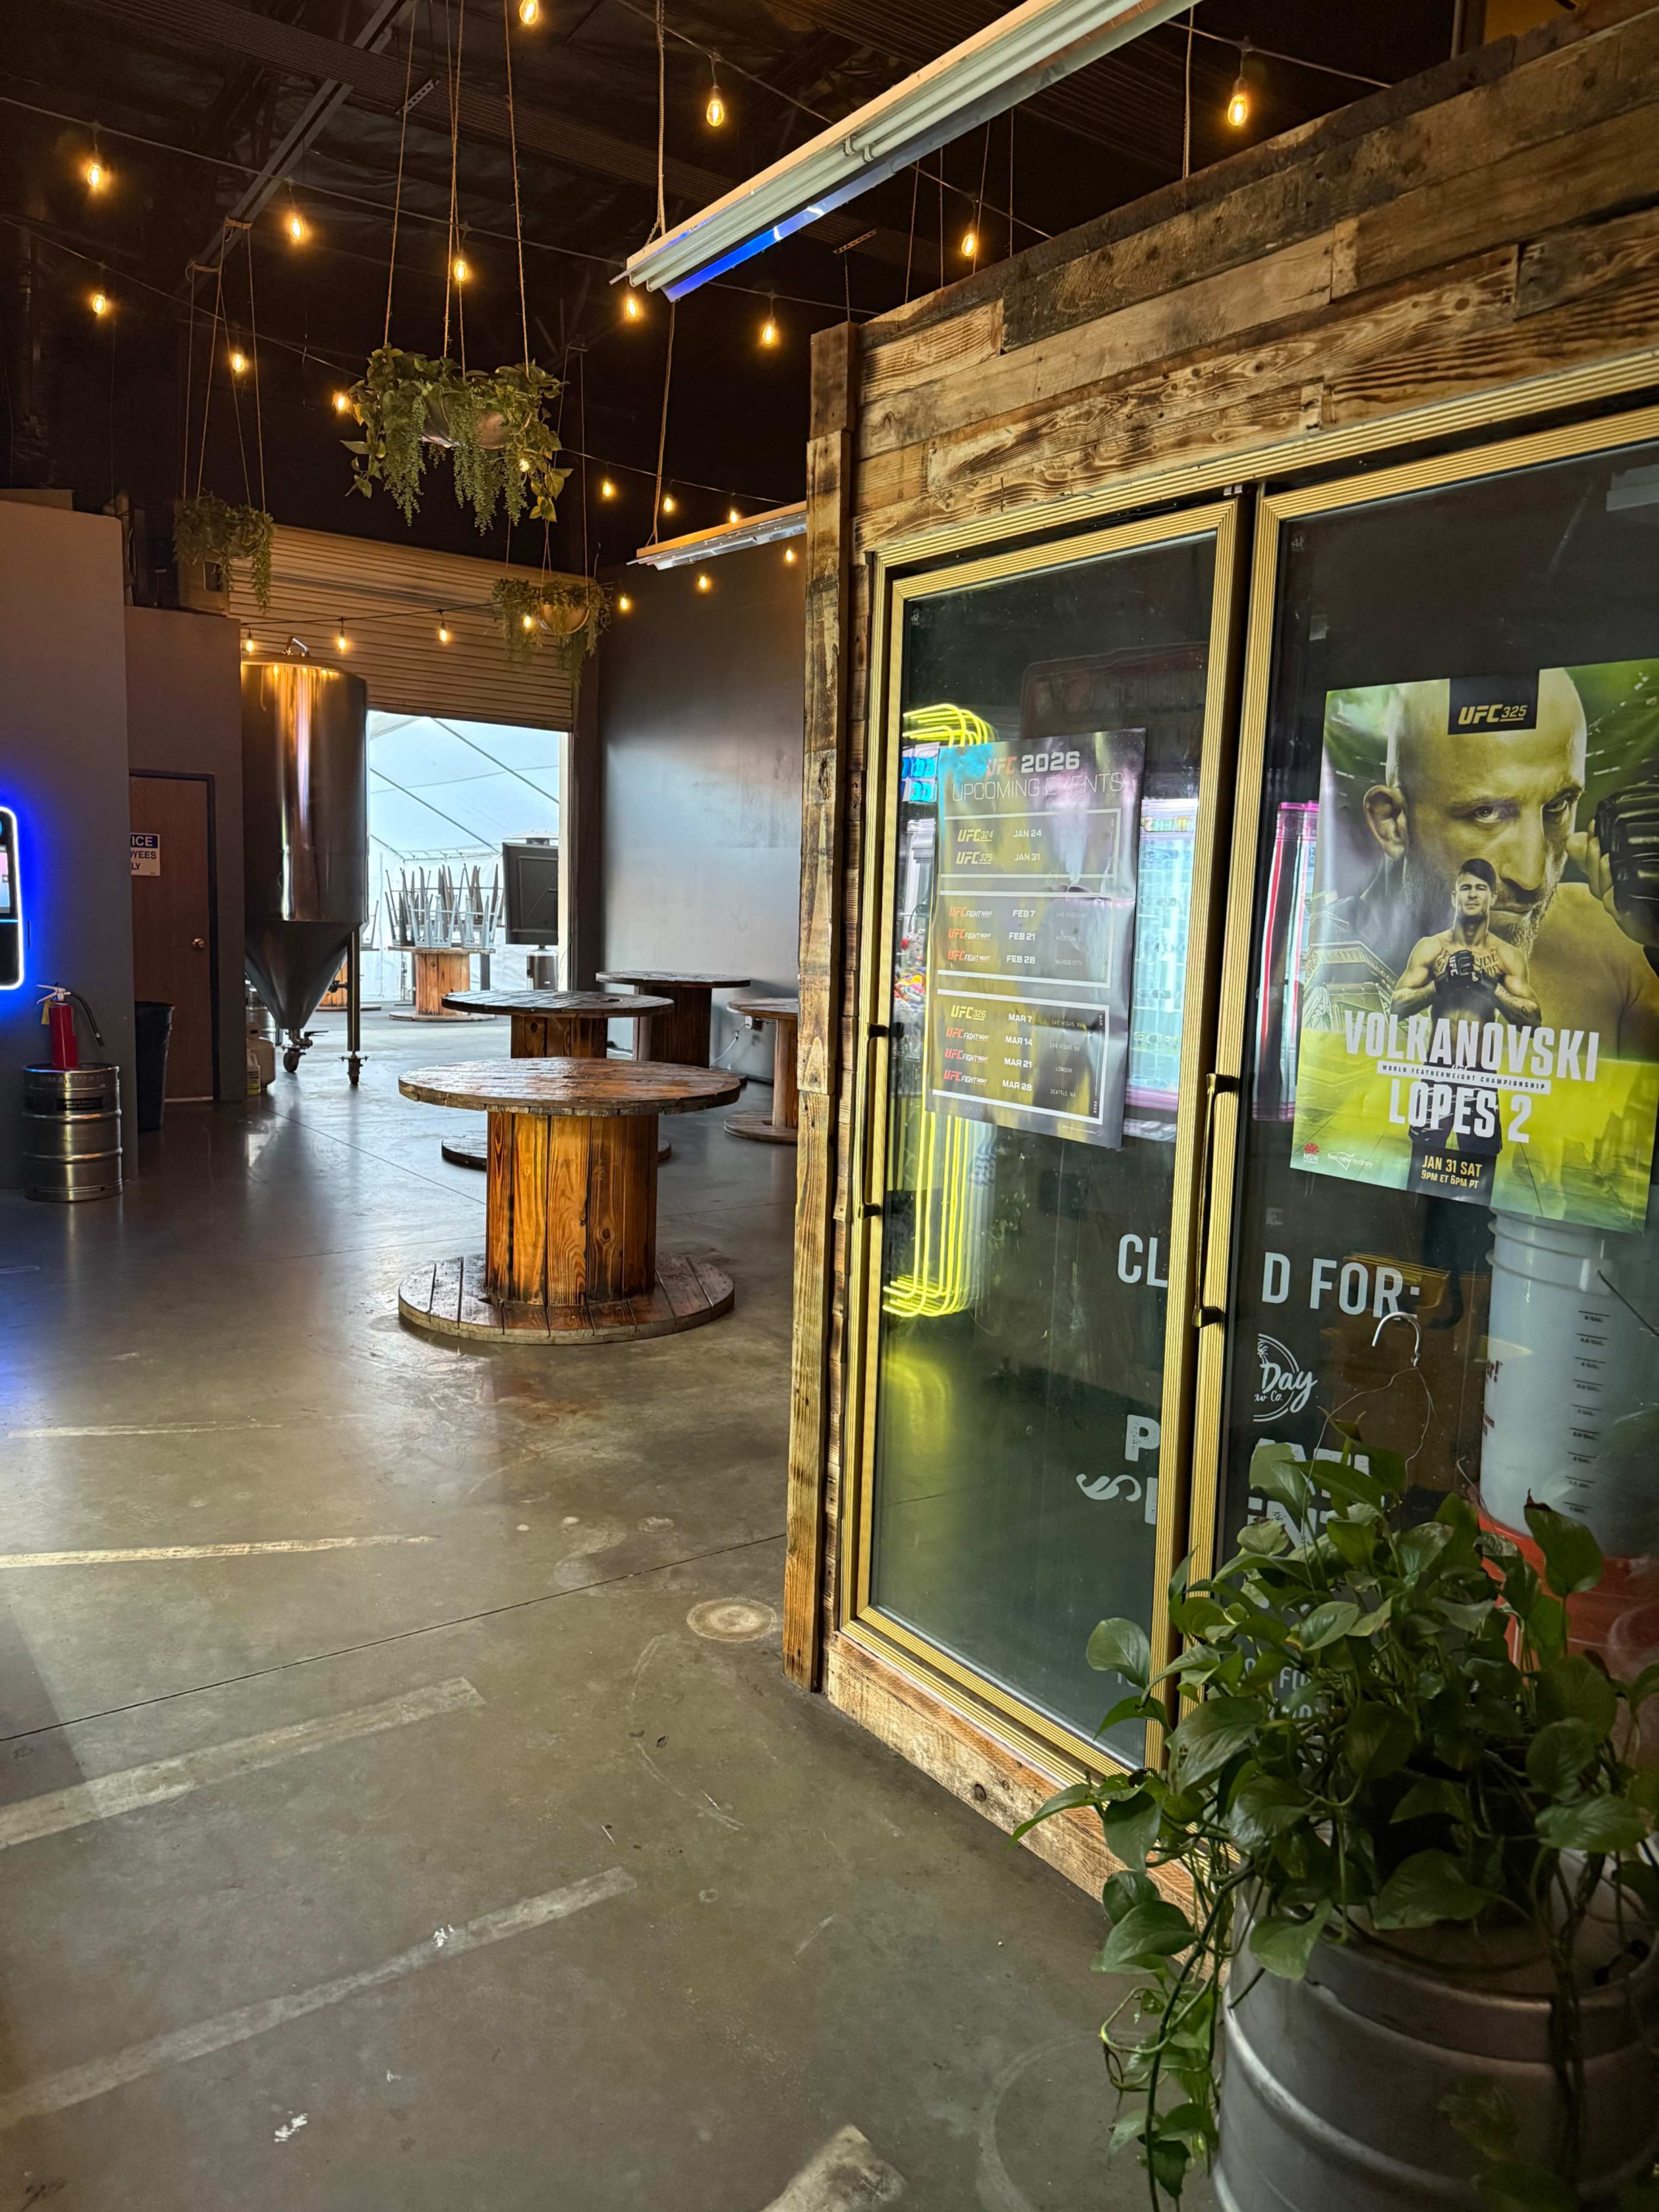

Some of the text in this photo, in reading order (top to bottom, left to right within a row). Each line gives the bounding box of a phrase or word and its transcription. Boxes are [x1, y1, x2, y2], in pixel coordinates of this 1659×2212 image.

[1458, 704, 1528, 725] UFC 325
[1021, 751, 1080, 773] 2026
[953, 779, 1039, 801] UPCOMING
[1046, 773, 1123, 797] EVENTS
[131, 836, 153, 847] ICE
[957, 829, 981, 842] UFC
[1014, 830, 1030, 838] JAN
[956, 851, 980, 864] UFC
[1014, 853, 1030, 861] JAN
[1009, 932, 1025, 940] FEB
[1007, 955, 1023, 964] FEB
[1023, 956, 1035, 964] 28
[951, 1005, 973, 1019] UFC
[1008, 1013, 1026, 1022] MAR
[1005, 1036, 1023, 1045] MAR
[1024, 1038, 1033, 1046] 14
[1344, 1010, 1599, 1082] VOLKANOVSKI
[1004, 1057, 1022, 1067] MAR
[1002, 1080, 1021, 1089] MAR
[1022, 1083, 1032, 1091] 28
[1382, 1065, 1545, 1089] WORLD FEATHERWEIGHT CHAMPIONSHIP
[1389, 1079, 1532, 1143] LOPES 2
[1303, 1153, 1319, 1162] NSW
[1422, 1155, 1482, 1177] JAN 31 SAT
[1421, 1170, 1479, 1189] 9PM ET 6PM PT
[1260, 1362, 1318, 1413] Day
